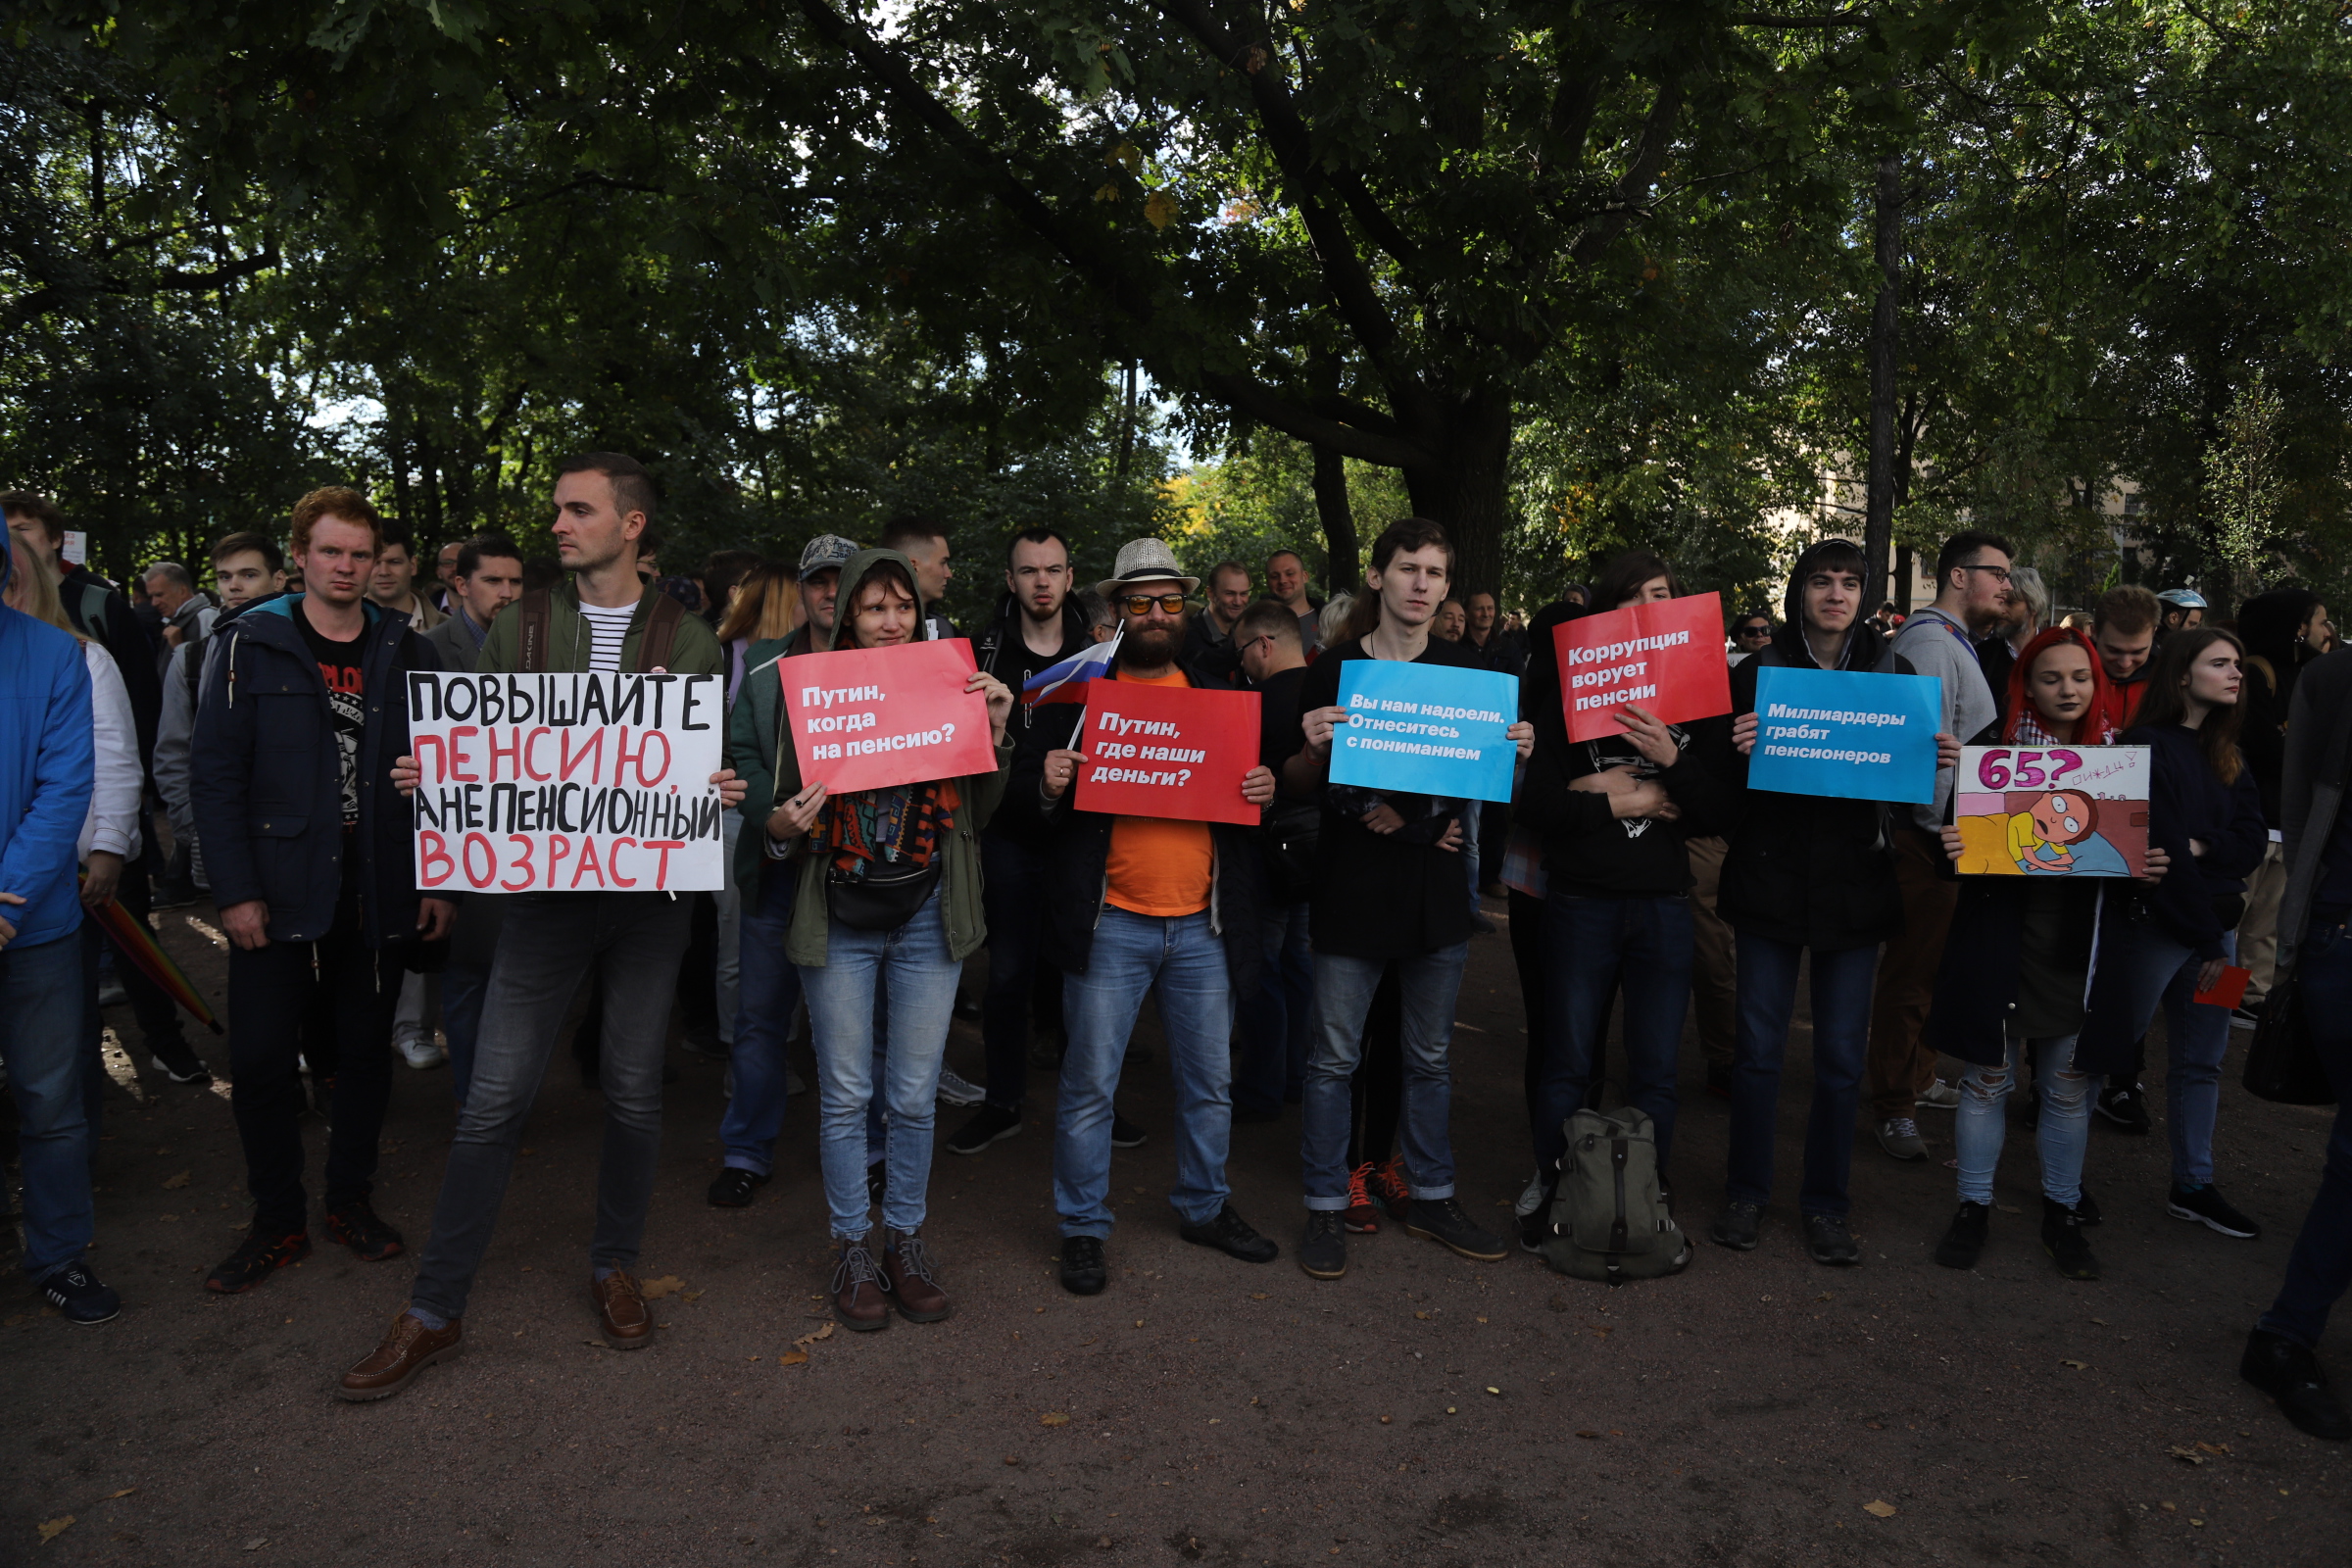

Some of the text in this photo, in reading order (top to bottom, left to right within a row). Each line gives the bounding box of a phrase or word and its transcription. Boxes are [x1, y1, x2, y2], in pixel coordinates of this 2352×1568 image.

[525, 624, 535, 671] DAKINE
[1568, 630, 1690, 666] Коррупция
[1572, 662, 1647, 688] ворует
[409, 673, 714, 730] ПОВЫШАЙТЕ
[802, 685, 886, 709] Путин,
[1349, 693, 1505, 723] Вы нам надоели.
[1576, 684, 1656, 710] пенсии
[808, 711, 876, 733] когда
[1099, 711, 1181, 739] Путин,
[1348, 713, 1460, 738] Отнеситесь
[1768, 703, 1906, 727] Миллиардеры
[812, 723, 956, 760] на пенсию?
[1766, 724, 1831, 740] грабят
[414, 725, 678, 795] ПЕНСИЮ,
[1095, 741, 1206, 763] где наши
[1347, 736, 1481, 760] с пониманием
[1764, 745, 1891, 764] пенсионеров
[1090, 766, 1192, 787] деньги?
[1978, 749, 2083, 790] 65?
[490, 782, 720, 841] ПЕНСИОННЫЙ
[419, 830, 685, 891] ВОЗРАСТ
